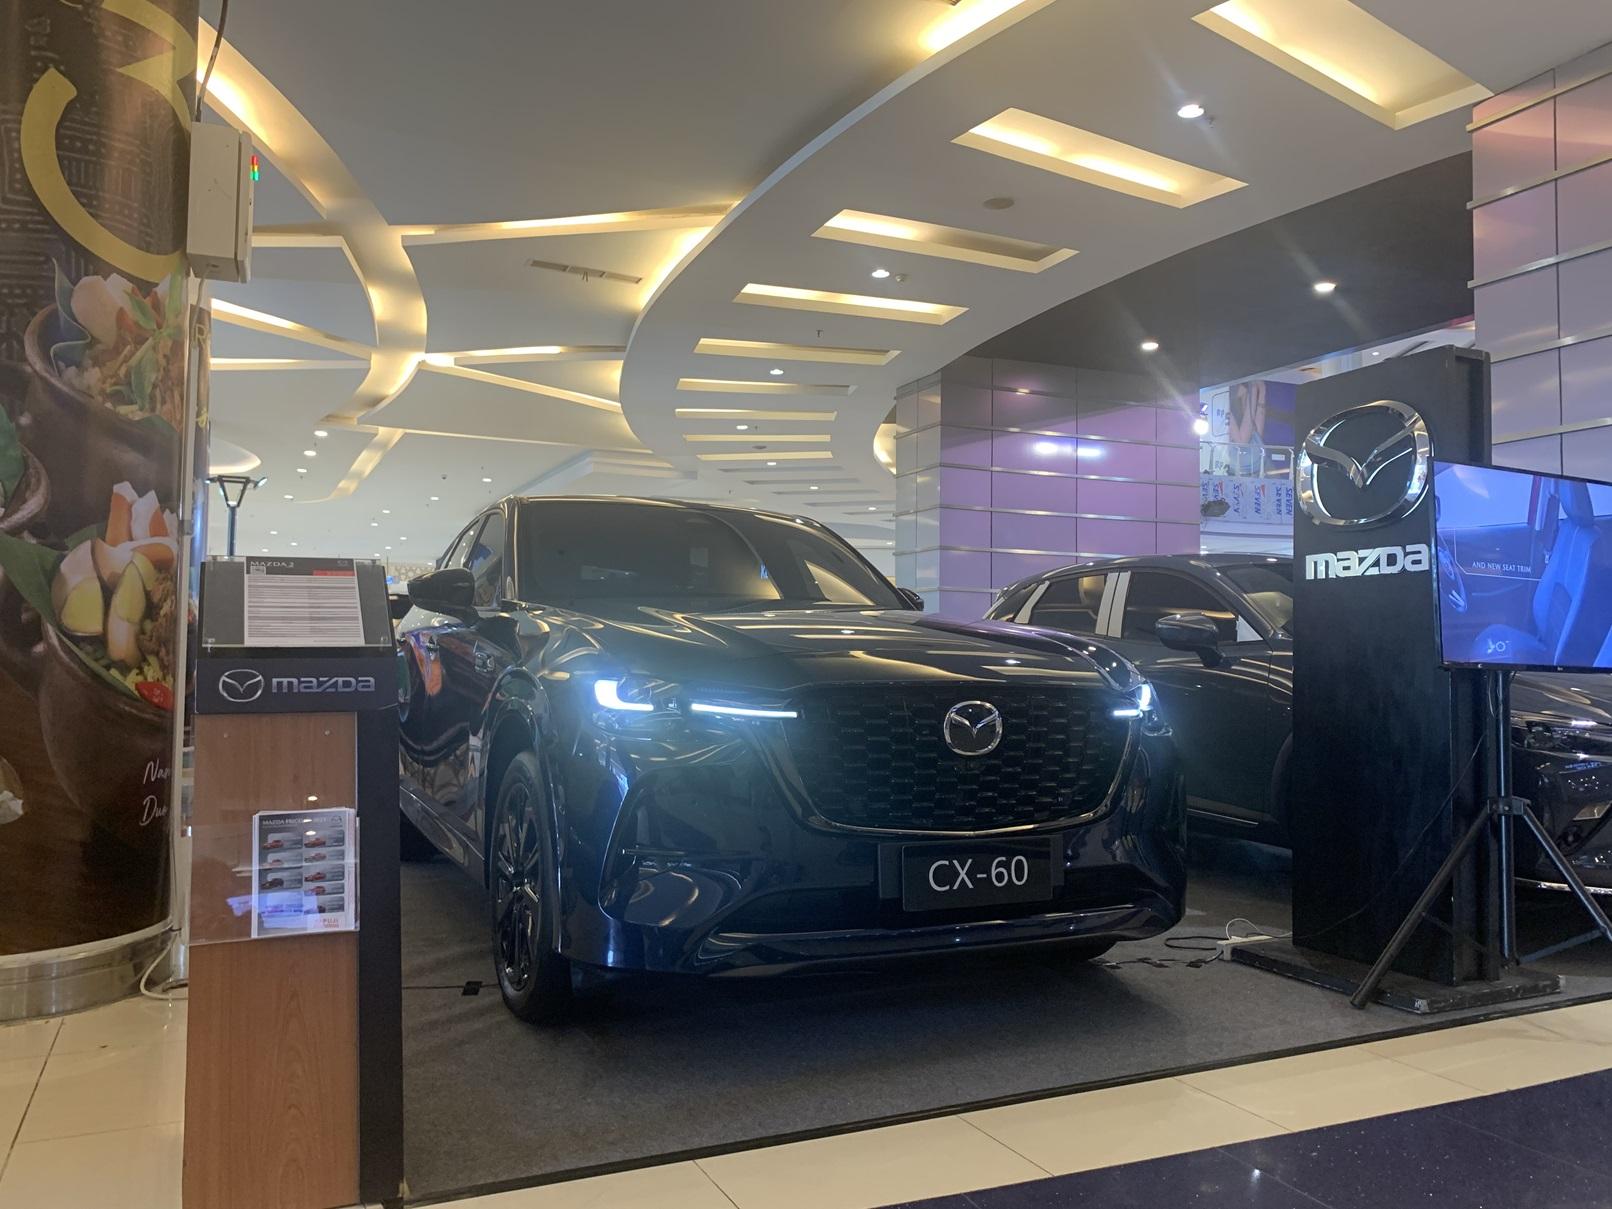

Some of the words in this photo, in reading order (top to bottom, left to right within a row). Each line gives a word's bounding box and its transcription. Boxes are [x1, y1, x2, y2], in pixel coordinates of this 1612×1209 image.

[1472, 561, 1486, 569] AND
[1487, 562, 1501, 570] NEW
[1502, 563, 1516, 572] SEAT
[1517, 564, 1532, 573] TRIM
[928, 855, 1029, 892] CX-60
